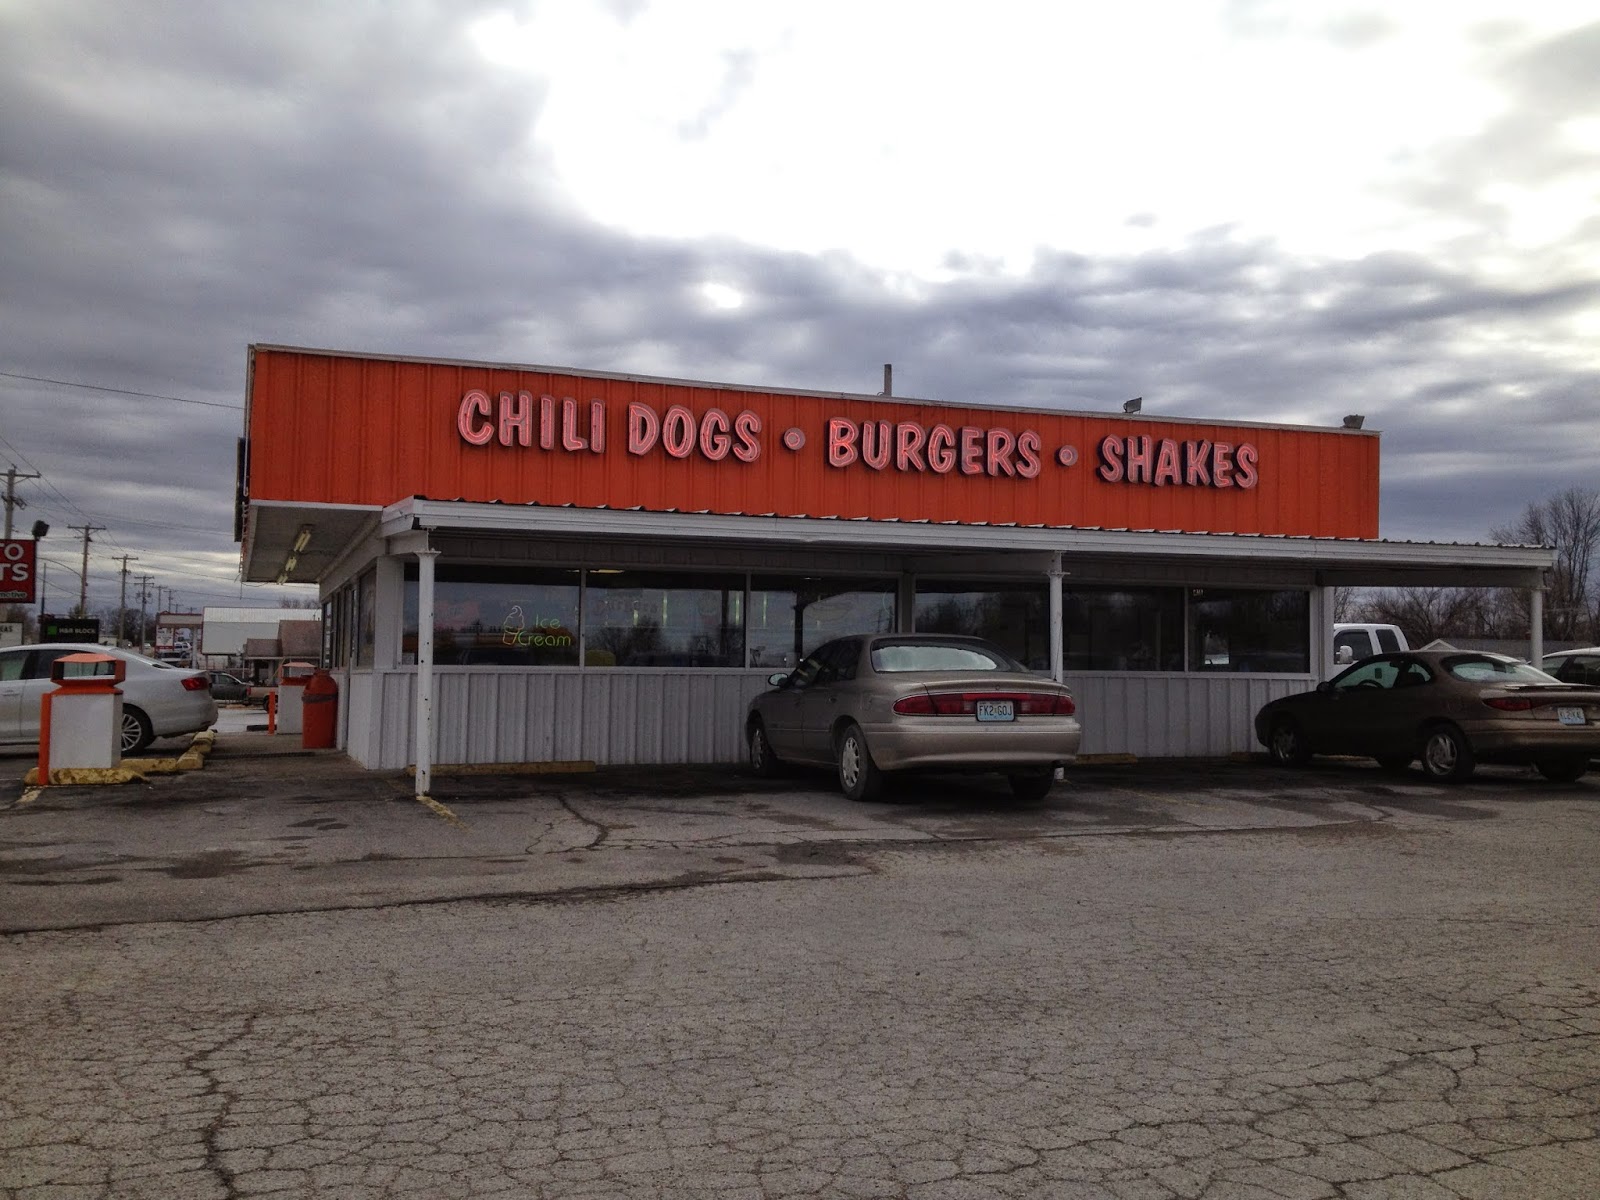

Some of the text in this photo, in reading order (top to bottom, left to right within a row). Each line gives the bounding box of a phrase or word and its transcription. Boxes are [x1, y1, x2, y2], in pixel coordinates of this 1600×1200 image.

[457, 388, 1259, 489] CHILI DOGS BURGERS SHAKES
[535, 614, 561, 629] Ice
[518, 631, 571, 647] Cream
